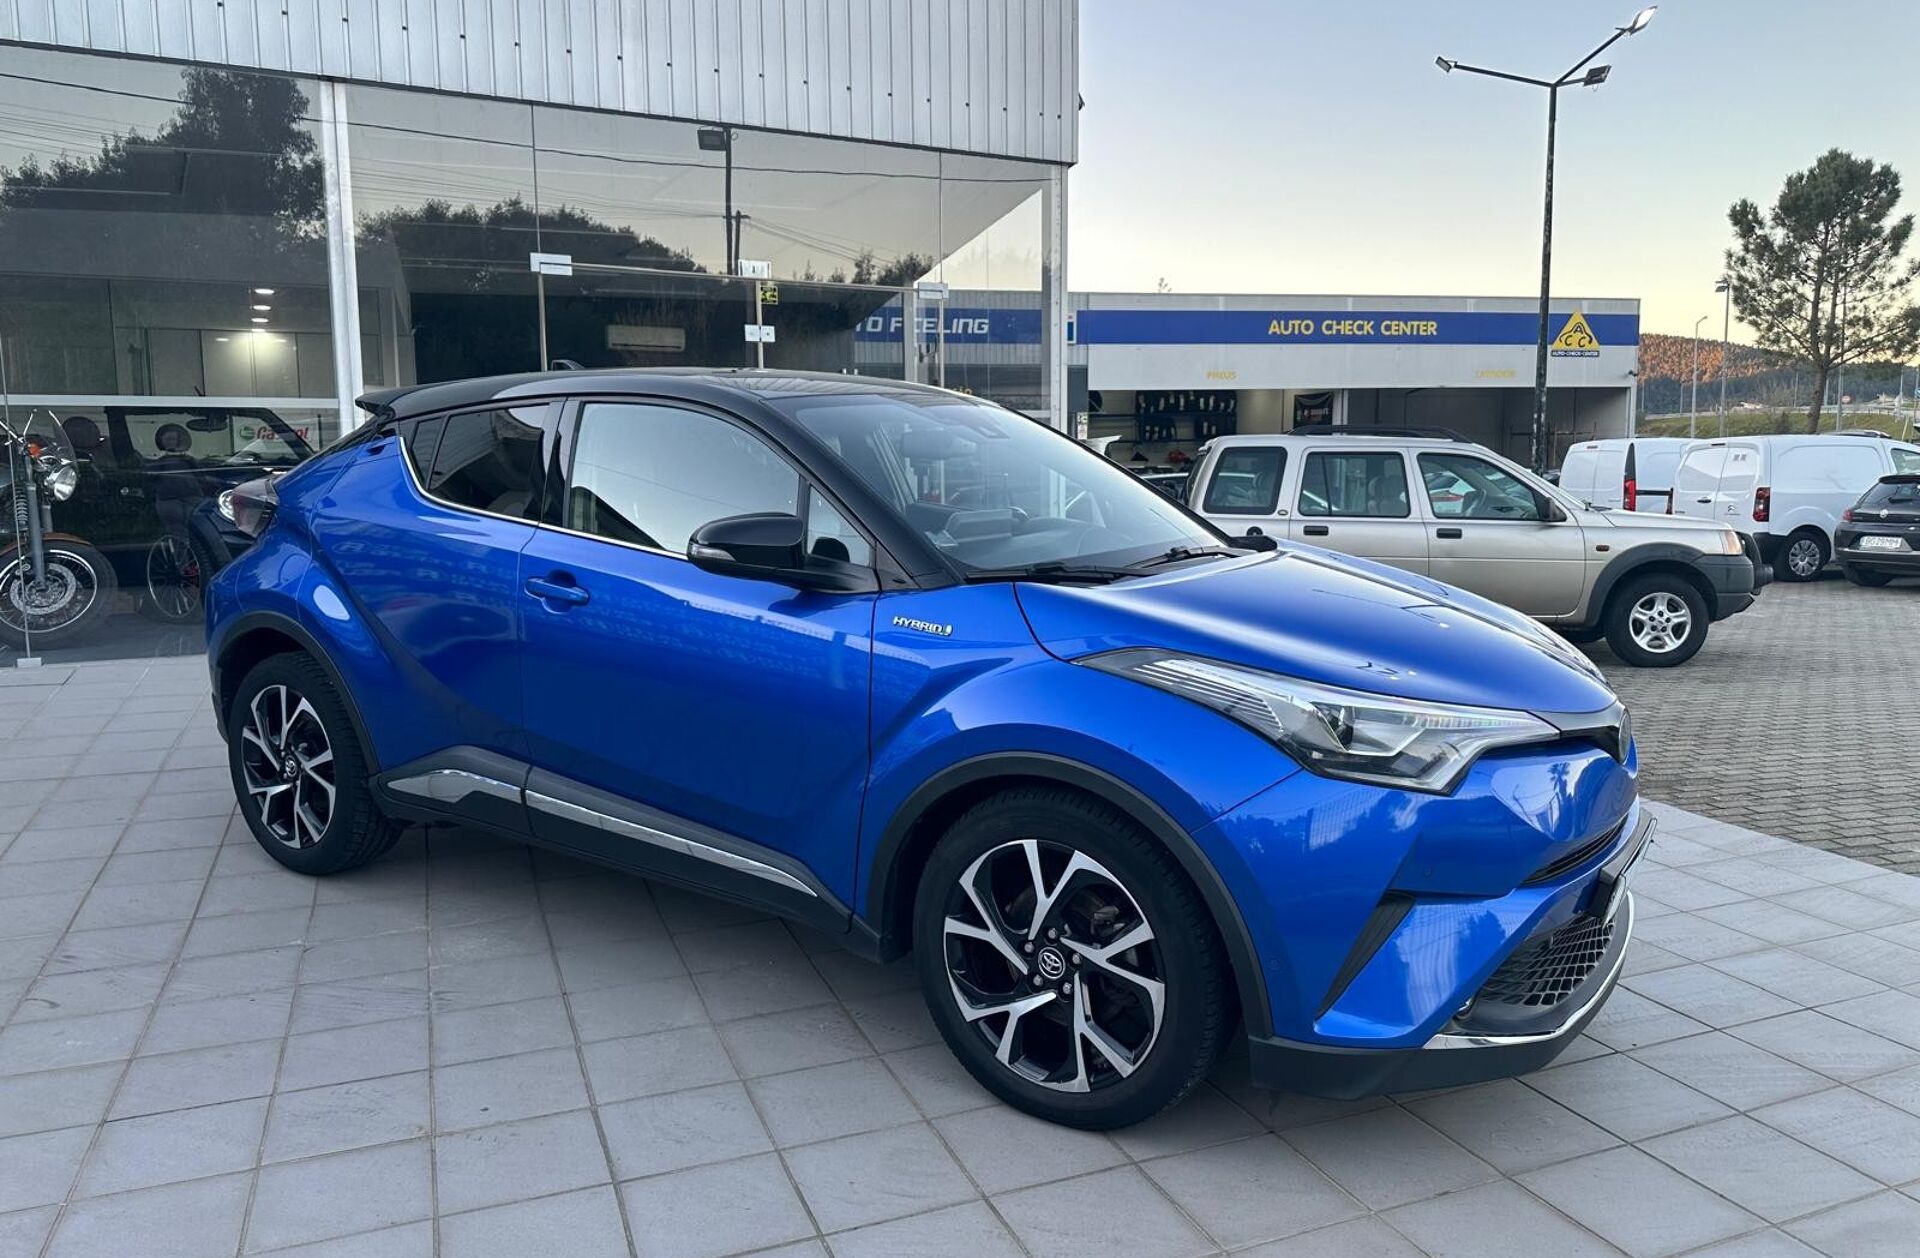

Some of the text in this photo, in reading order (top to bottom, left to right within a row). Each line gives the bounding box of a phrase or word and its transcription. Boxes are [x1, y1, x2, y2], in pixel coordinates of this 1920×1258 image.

[1268, 319, 1438, 336] AUTO CHECK CENTER
[893, 616, 943, 634] HYBRID
